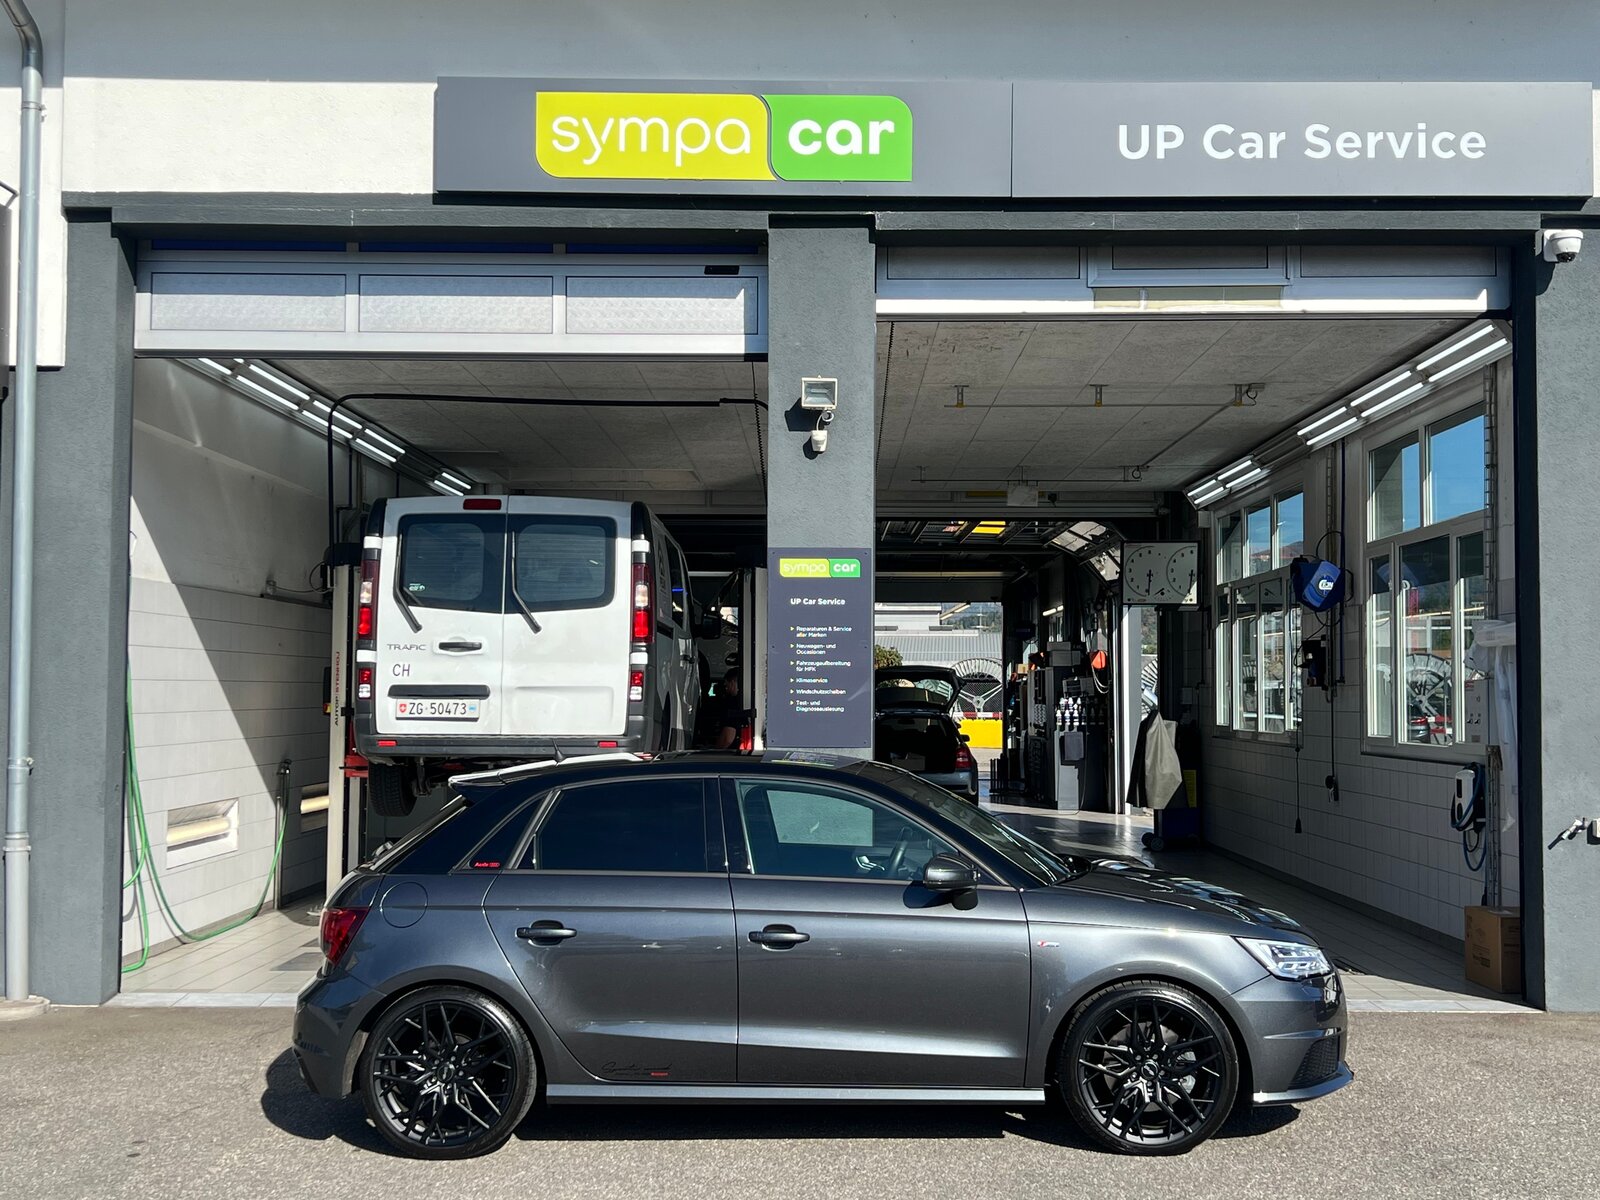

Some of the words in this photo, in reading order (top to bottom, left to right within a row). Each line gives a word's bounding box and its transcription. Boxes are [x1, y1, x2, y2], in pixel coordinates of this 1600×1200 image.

[551, 115, 751, 168] sympa
[788, 118, 896, 156] car
[1118, 124, 1185, 160] UP
[1202, 123, 1286, 160] Car
[1303, 122, 1487, 159] Service
[783, 562, 827, 576] sympa
[833, 562, 857, 573] car
[386, 643, 427, 651] TRAFIC
[392, 663, 411, 677] CH
[796, 705, 845, 713] Diagnoseauslesung
